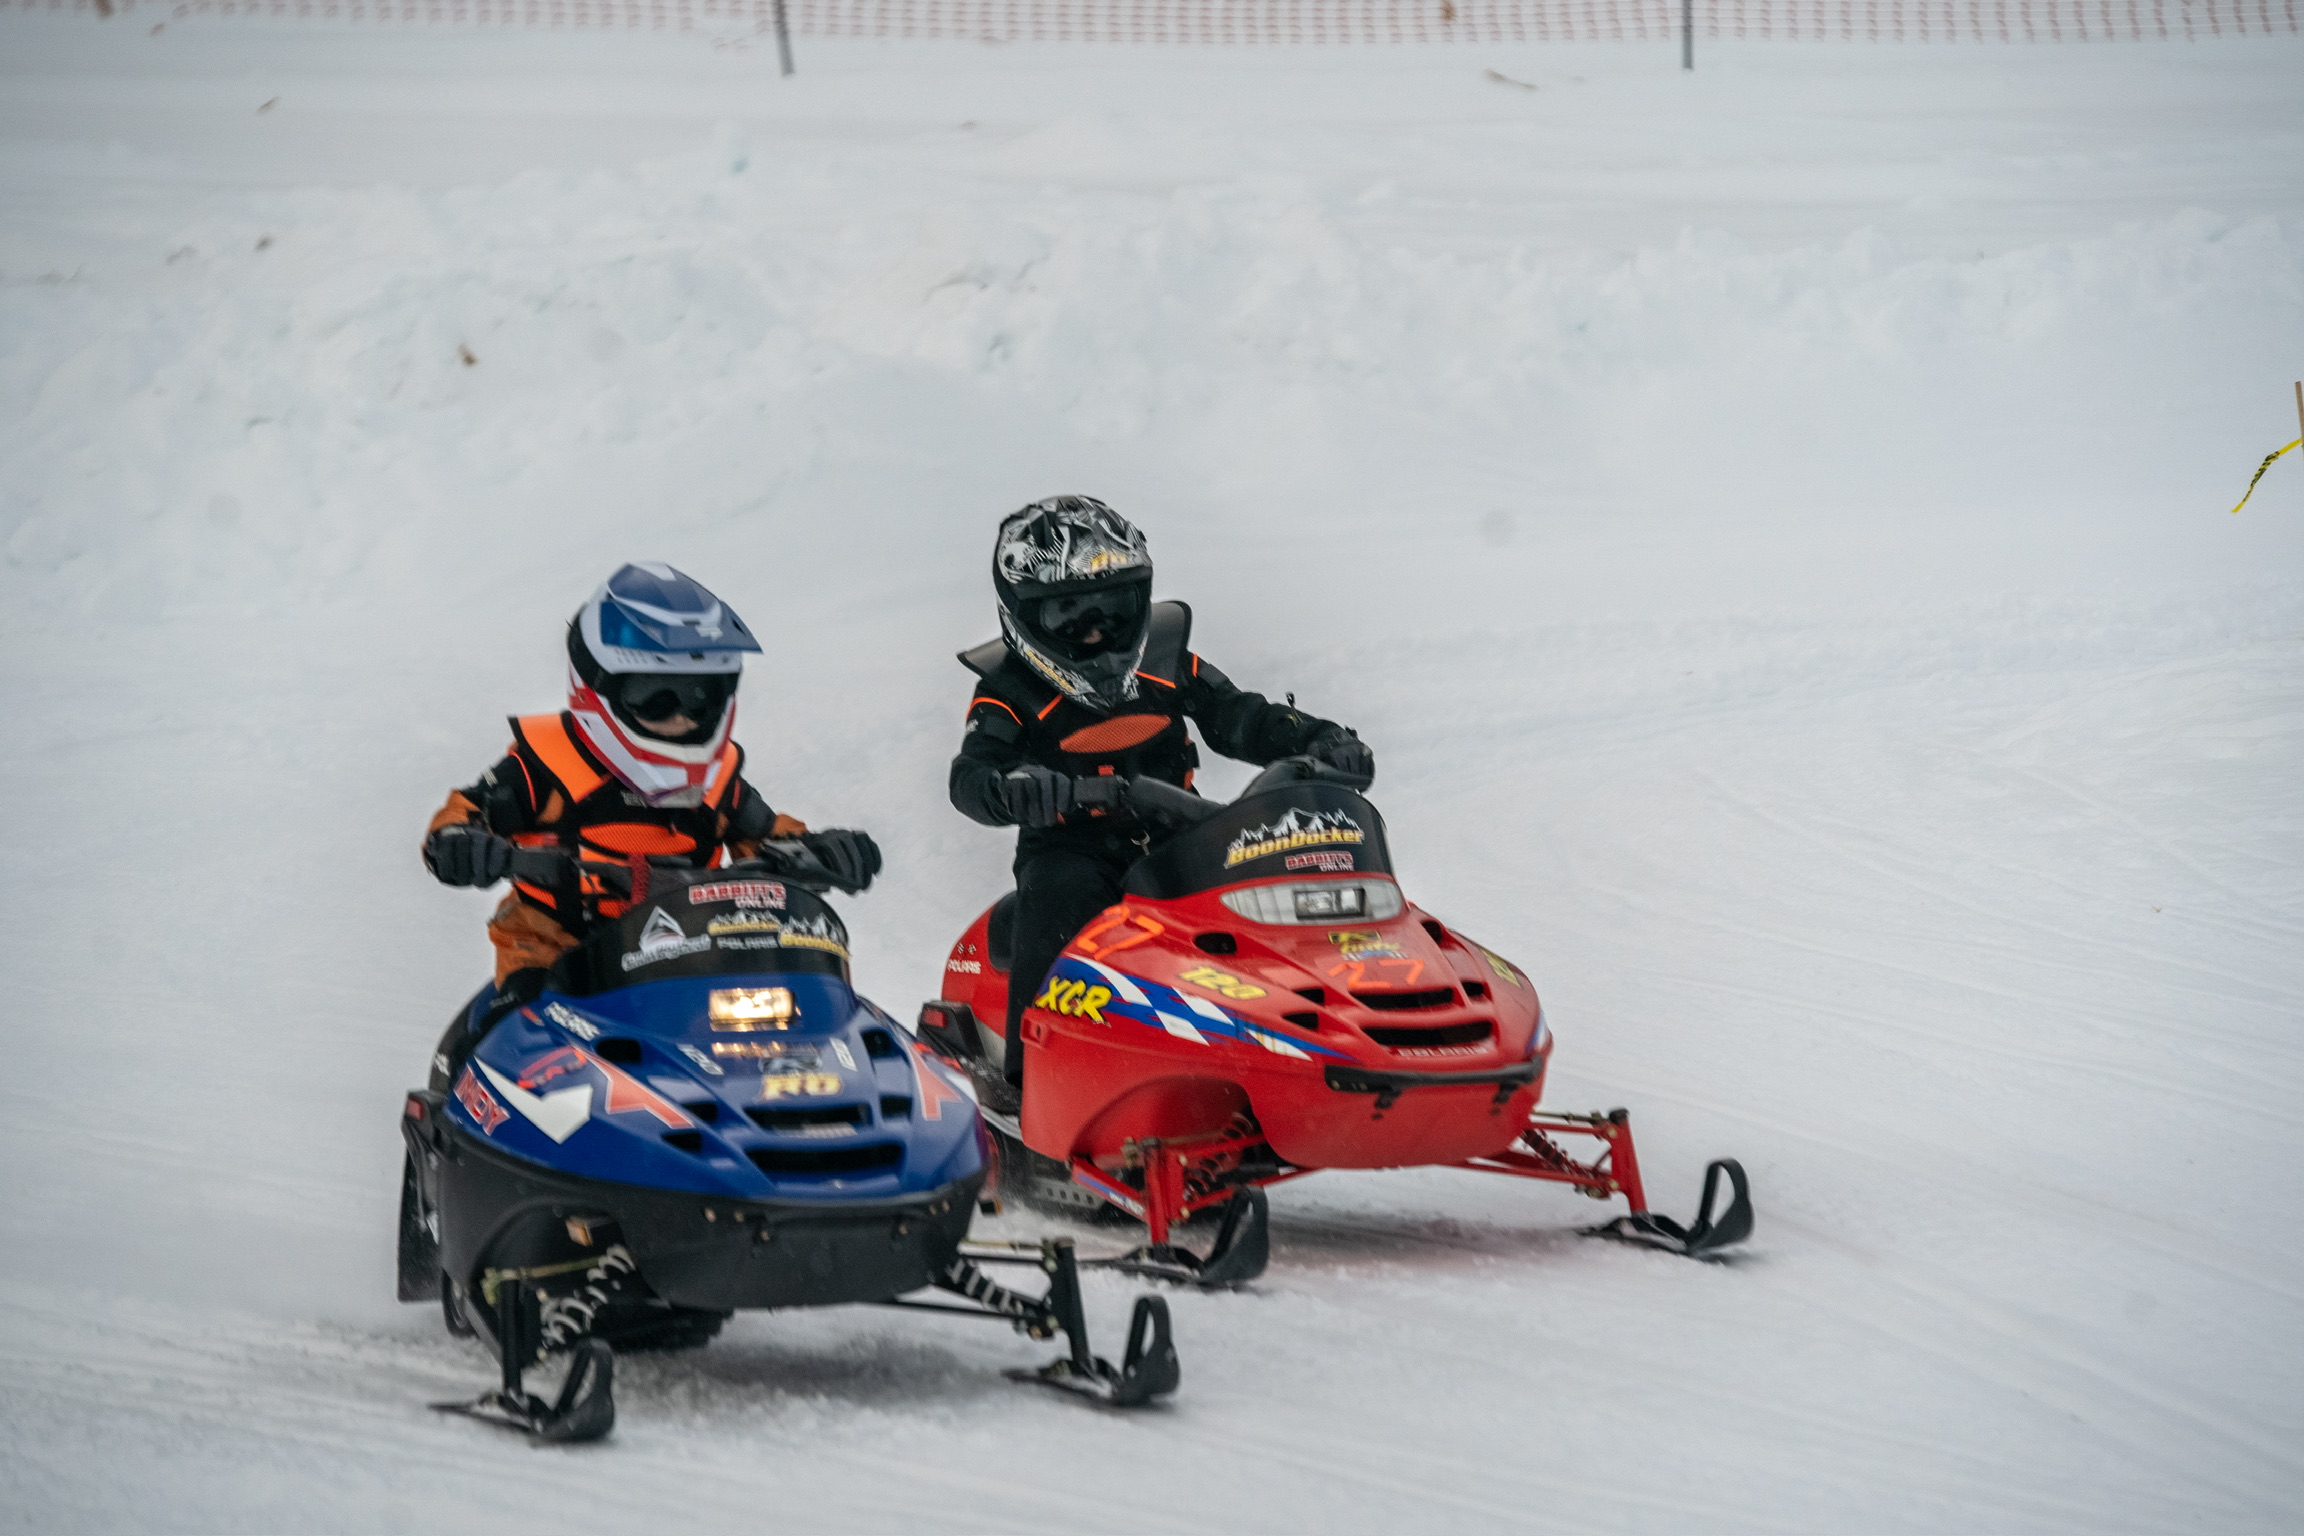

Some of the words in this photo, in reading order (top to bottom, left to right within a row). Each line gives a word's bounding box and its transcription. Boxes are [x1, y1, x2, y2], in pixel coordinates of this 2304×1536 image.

[735, 896, 787, 909] ONLINE
[1328, 960, 1425, 989] 27
[1036, 975, 1114, 1024] XCR
